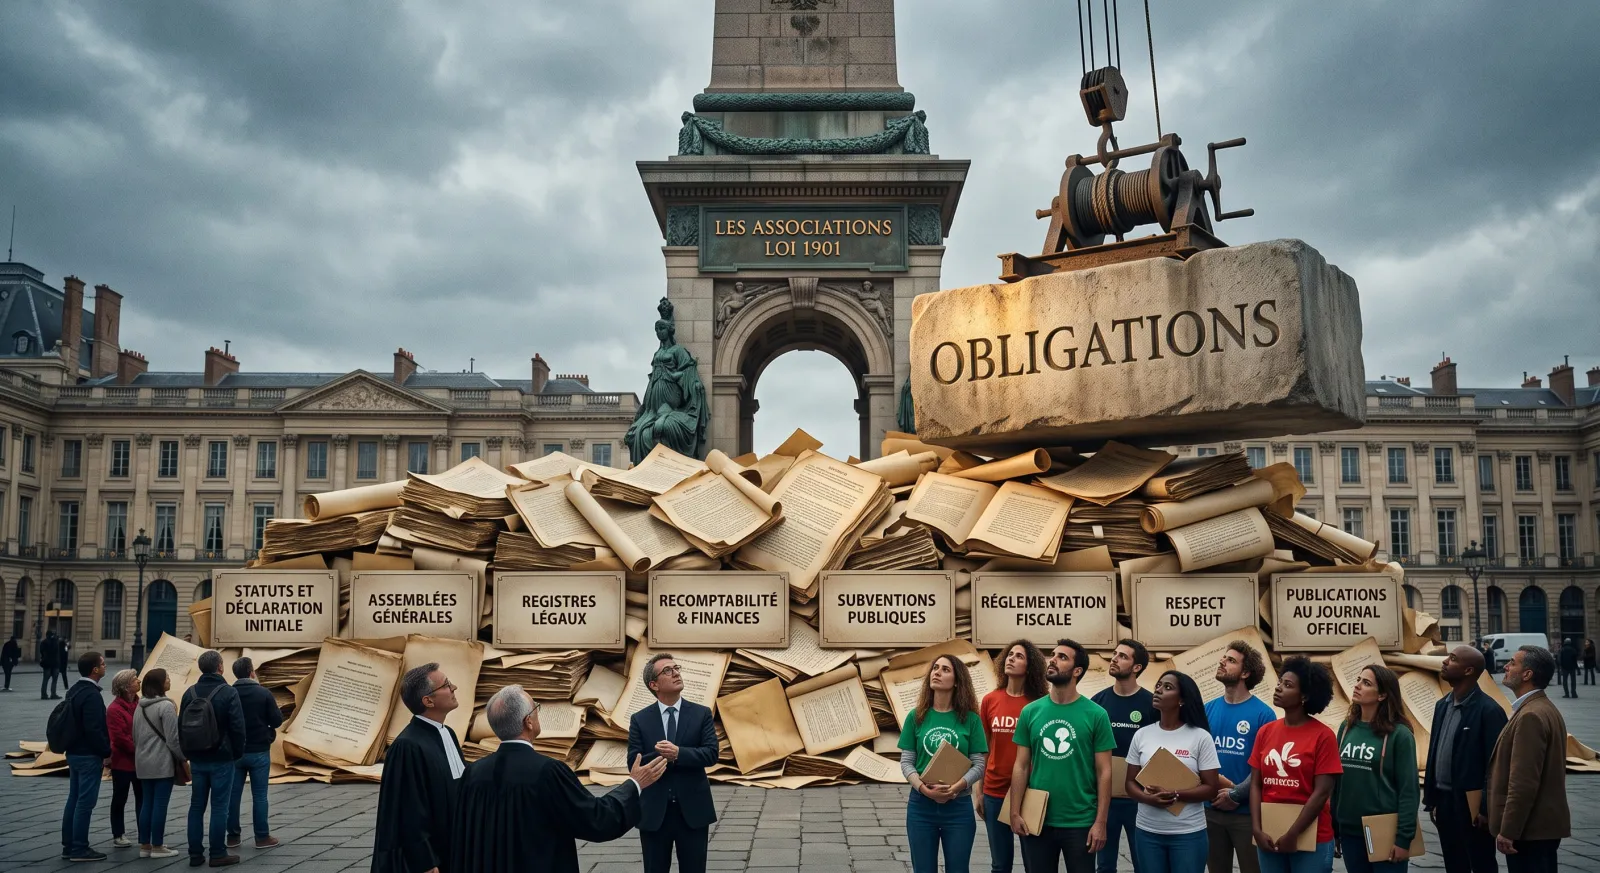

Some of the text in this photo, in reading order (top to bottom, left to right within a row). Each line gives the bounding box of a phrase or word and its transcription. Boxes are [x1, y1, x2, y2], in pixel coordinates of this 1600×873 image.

[715, 219, 893, 236] LES ASSOCIATIONS
[764, 240, 842, 257] LOI 1901
[929, 299, 1281, 386] OBLIGATIONS
[234, 584, 315, 598] STATUTS ET
[368, 590, 457, 607] ASSEMBLÉES
[1286, 588, 1387, 602] PUBLICATIONS
[225, 598, 324, 615] DÉCLARATION
[522, 594, 597, 608] REGISTRES
[659, 592, 778, 608] RECOMPTABILITÉ
[837, 593, 936, 607] SUBVENTIONS
[981, 592, 1106, 609] RÉGLEMENTATION
[1165, 596, 1226, 610] RESPECT
[372, 608, 453, 624] GÉNÉRALES
[532, 609, 587, 625] LÉGAUX
[677, 611, 760, 625] & FINANCES
[848, 610, 926, 626] PUBLIQUES
[1016, 613, 1072, 626] FISCALE
[1293, 605, 1381, 619] AU JOURNAL
[244, 618, 304, 632] INITIALE
[1170, 614, 1222, 627] DU BUT
[1307, 622, 1368, 636] OFFICIEL
[1214, 735, 1246, 750] AIDS
[1340, 742, 1375, 760] Arts
